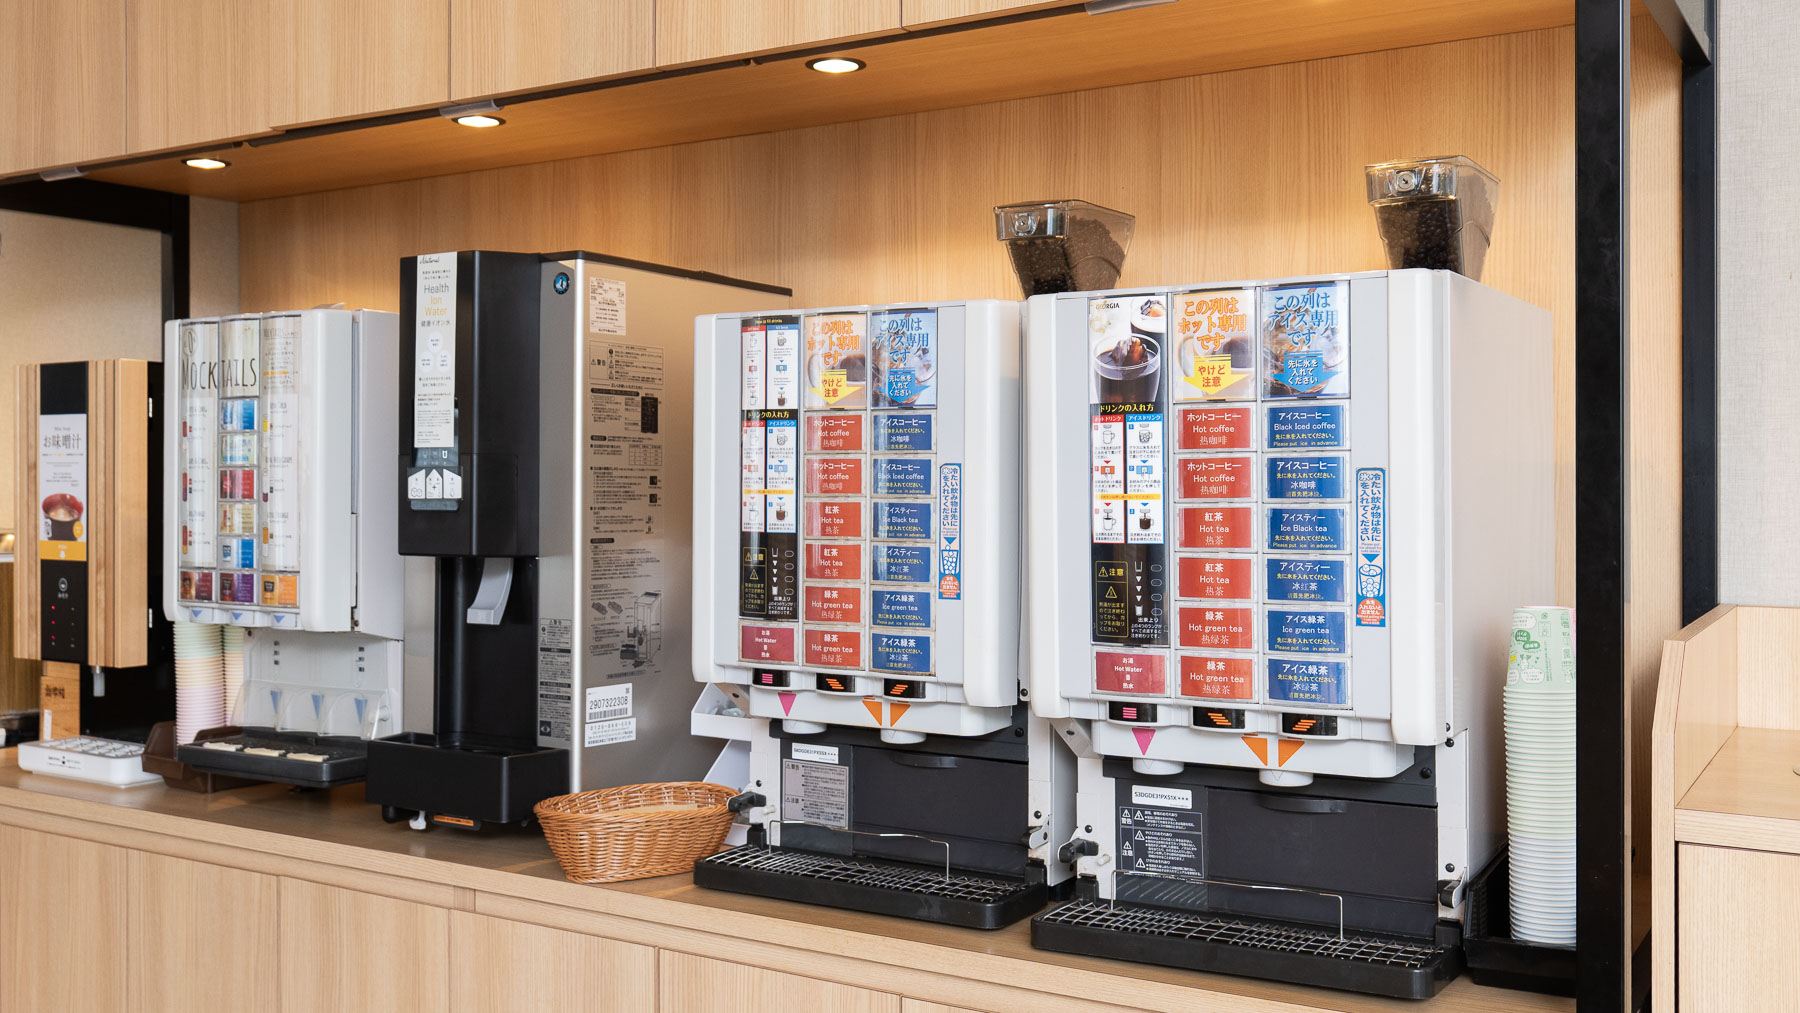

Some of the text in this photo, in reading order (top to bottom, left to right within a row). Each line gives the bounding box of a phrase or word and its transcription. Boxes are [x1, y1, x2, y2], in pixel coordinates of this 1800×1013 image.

[424, 283, 449, 294] Health
[430, 296, 443, 305] Ion
[1274, 292, 1331, 311] この列は
[1185, 297, 1239, 316] この列は
[425, 307, 448, 317] Water
[1178, 314, 1247, 334] ホット専用
[1268, 310, 1337, 329] アイス専用
[880, 318, 922, 332] この列は
[876, 333, 928, 348] アイス専用
[1197, 332, 1225, 351] です
[1288, 328, 1316, 346] です
[808, 335, 859, 351] ホット専用
[822, 350, 842, 366] です
[889, 349, 910, 363] です
[1288, 360, 1319, 368] 先に氷を
[182, 358, 257, 390] MOCKTAILS
[1198, 365, 1226, 375] やけど
[1292, 368, 1314, 376] 入れて
[822, 378, 842, 387] やけど
[1202, 377, 1221, 387] 注意
[1288, 376, 1318, 385] ください
[825, 388, 839, 397] 注意
[889, 389, 912, 397] ください
[1100, 404, 1154, 412] ドリンクの入れ方
[1187, 412, 1242, 422] ホットコーヒー
[1279, 412, 1331, 420] アイスコーヒー
[1192, 424, 1235, 433] Hot coffee
[1274, 423, 1292, 431] Black
[1312, 422, 1336, 430] coffee
[830, 429, 850, 437] coffee
[1275, 432, 1334, 440] 先に氷を入れてください。
[43, 434, 82, 449] お味噌汁
[1187, 462, 1242, 471] ホットコーヒー
[1276, 461, 1337, 470] アイスコーヒー
[830, 472, 849, 480] coffee
[906, 472, 924, 480] coffee
[1193, 474, 1235, 483] Hot coffee
[942, 467, 950, 527] 氷を入れてください
[950, 468, 958, 526] 冷たい飲み物は先に
[825, 505, 839, 514] 紅茶
[1359, 472, 1370, 541] 氷を入れてください
[1370, 473, 1381, 541] 冷たい飲み物は先に
[1204, 512, 1223, 522] 紅茶
[1282, 513, 1326, 522] アイスティー
[1199, 525, 1214, 533] Hot
[824, 548, 838, 556] 紅茶
[882, 548, 919, 556] アイスティー
[1204, 563, 1224, 573] 紅茶
[1280, 562, 1330, 572] アイスティー
[1109, 568, 1124, 576] 注意
[1199, 575, 1214, 583] Hot
[824, 590, 838, 598] 緑茶
[885, 594, 915, 602] アイス緑茶
[1205, 611, 1224, 620] 緑茶
[1285, 615, 1325, 624] アイス緑茶
[824, 633, 838, 642] 緑茶
[1276, 637, 1336, 645] 先に氷を入れてください。
[882, 638, 916, 647] アイス緑茶
[1206, 661, 1225, 671] 緑茶
[1282, 663, 1328, 675] アイス緑茶
[1190, 672, 1203, 680] Hot
[1277, 674, 1337, 683] 先に氷を入れてください。
[590, 696, 628, 709] 2907322308
